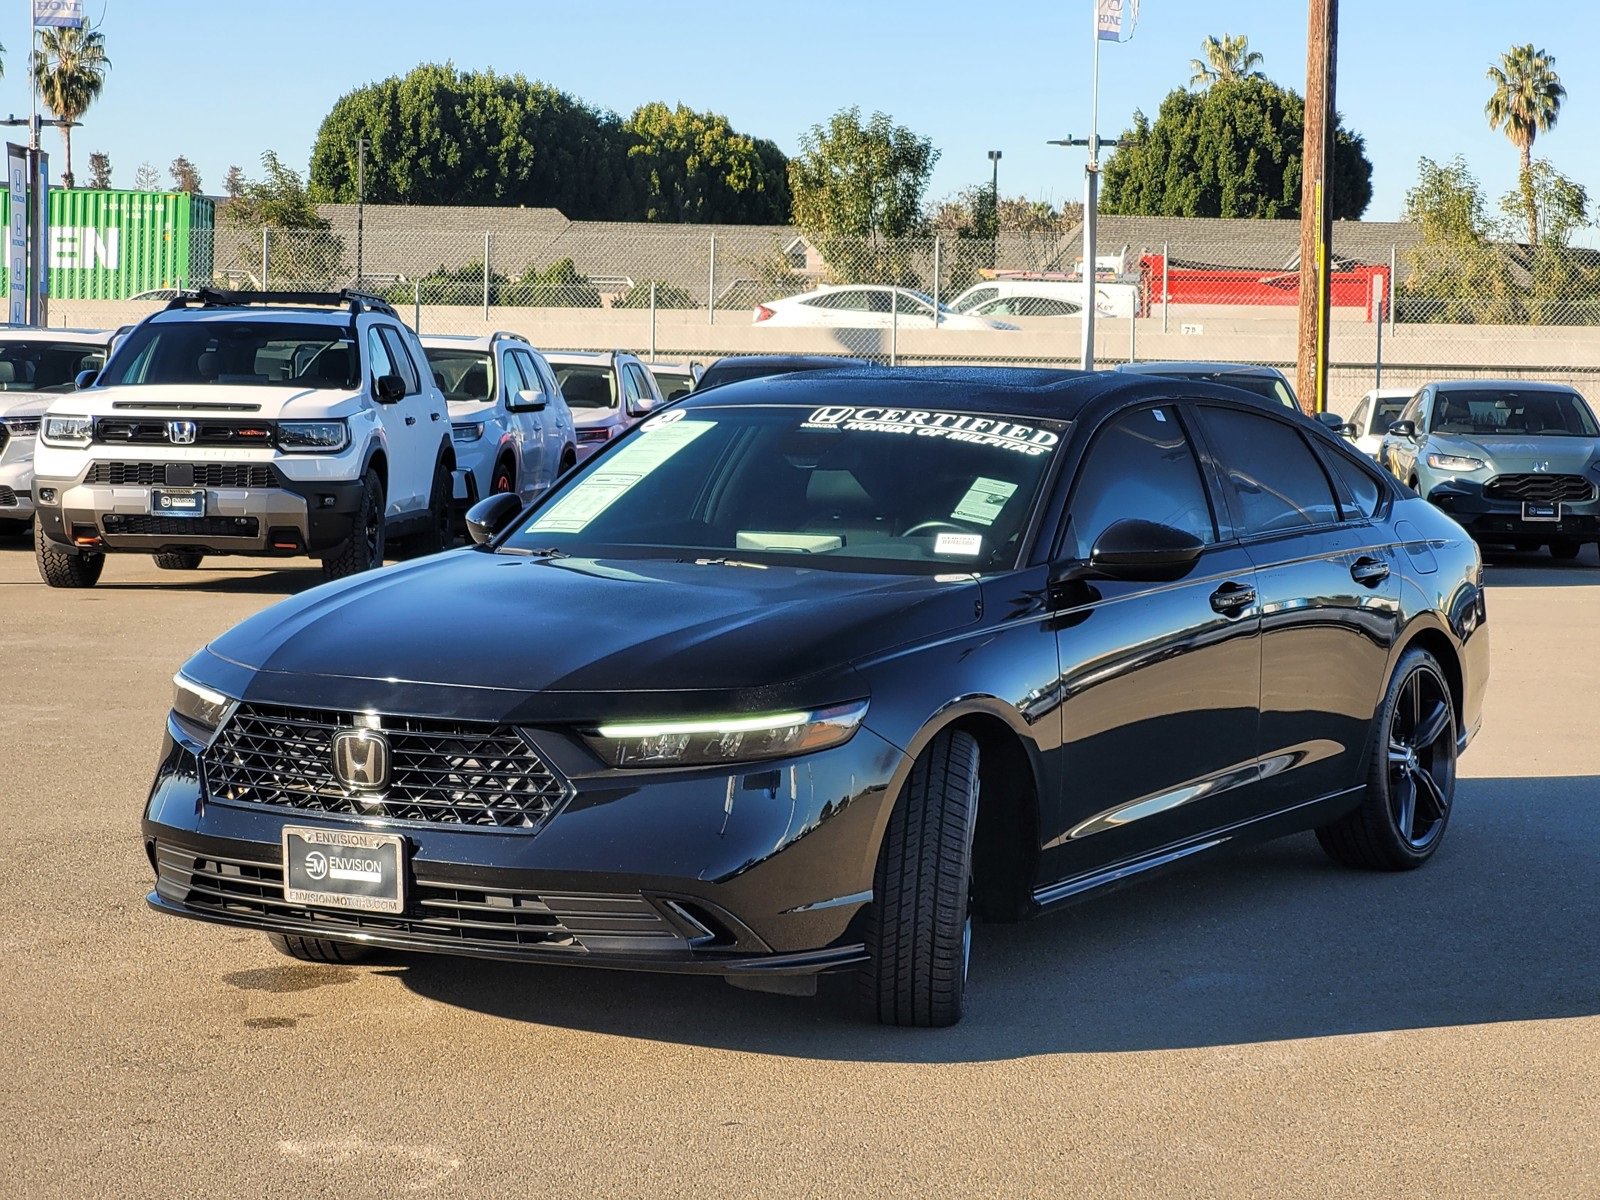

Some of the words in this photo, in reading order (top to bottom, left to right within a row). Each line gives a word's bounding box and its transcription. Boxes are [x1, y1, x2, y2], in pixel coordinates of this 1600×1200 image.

[843, 421, 915, 435] HONDA
[917, 427, 949, 437] OF
[945, 430, 1045, 455] MILPITAS
[855, 408, 1059, 446] CERTIFIED
[315, 831, 368, 846] ENVISION
[329, 856, 382, 873] ENVISION
